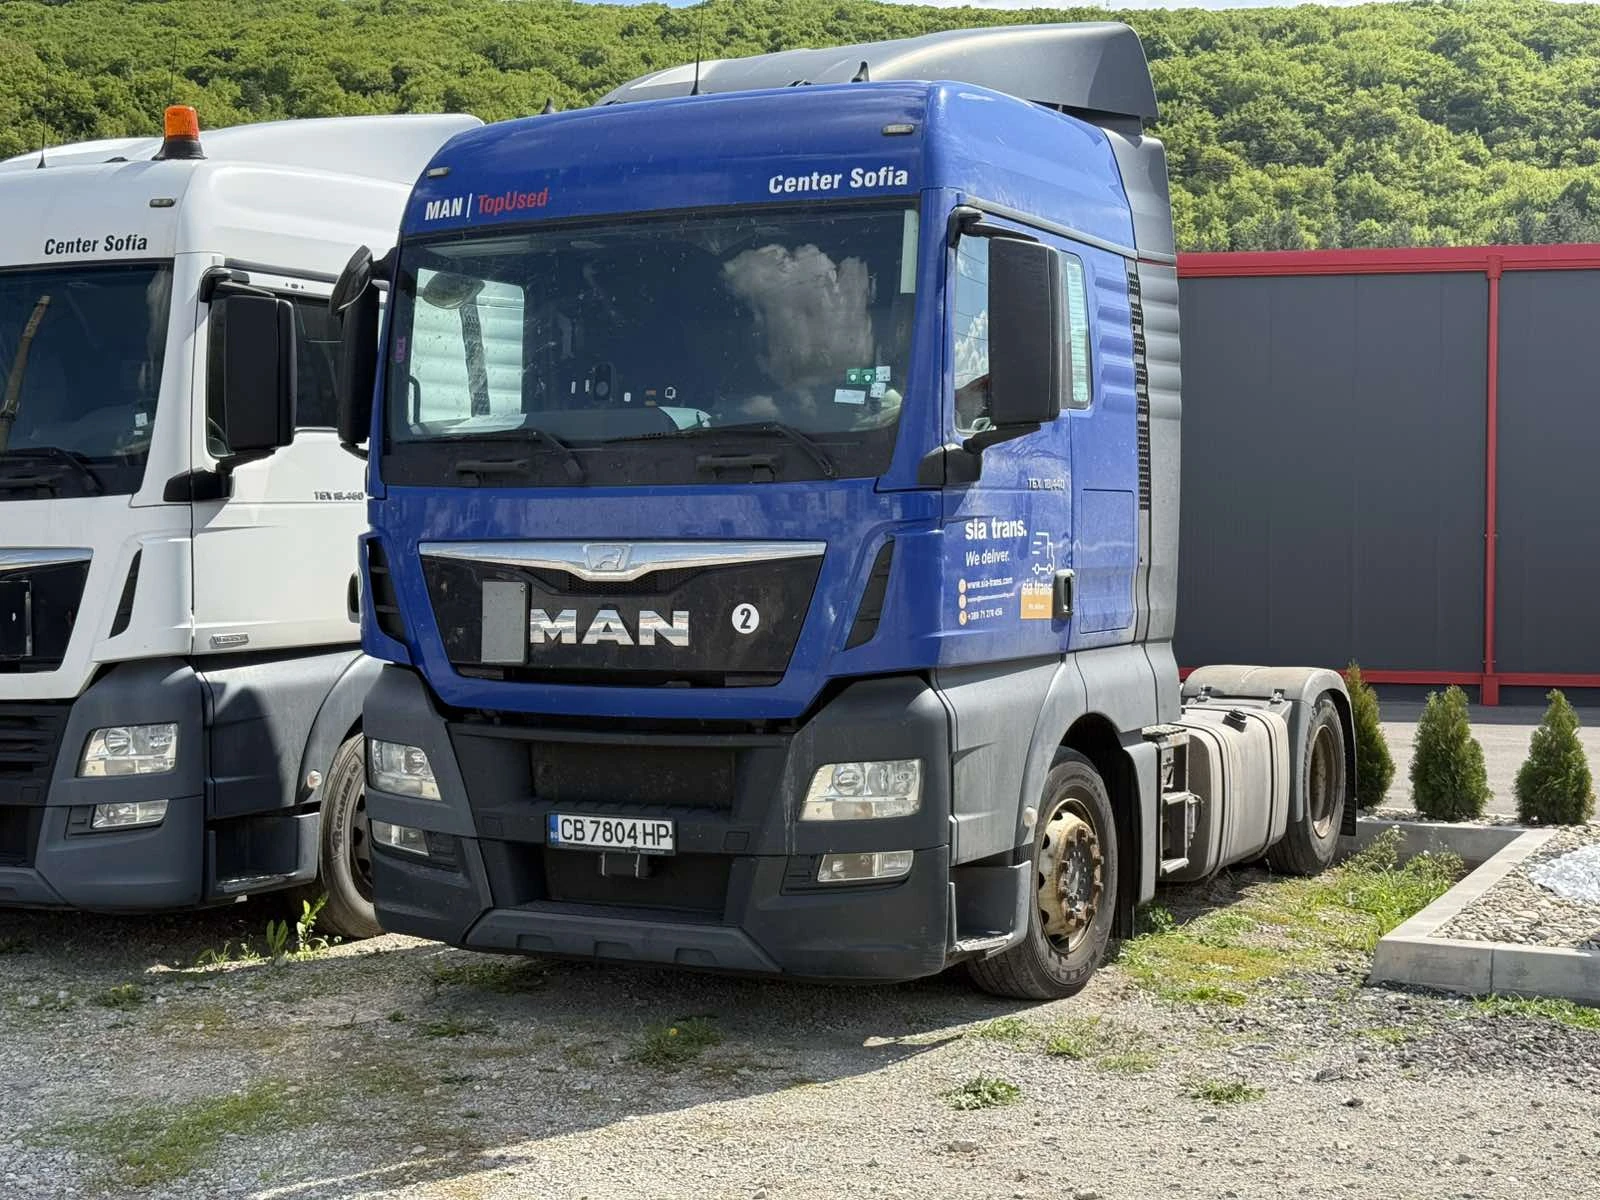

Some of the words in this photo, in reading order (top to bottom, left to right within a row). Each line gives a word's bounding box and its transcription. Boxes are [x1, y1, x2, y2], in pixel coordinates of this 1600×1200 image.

[768, 171, 843, 194] Center
[849, 165, 909, 188] Sofia
[424, 197, 464, 220] MAN
[478, 187, 550, 216] TopUsed
[44, 238, 99, 255] Center
[103, 234, 148, 252] Sofia
[965, 518, 987, 540] sia
[991, 517, 1027, 539] trans.
[965, 551, 980, 567] We
[981, 548, 1010, 564] deliver.
[530, 608, 690, 647] MAN
[740, 607, 751, 630] 2
[561, 818, 585, 841] CB
[589, 820, 638, 845] 7804
[642, 822, 669, 846] HP
